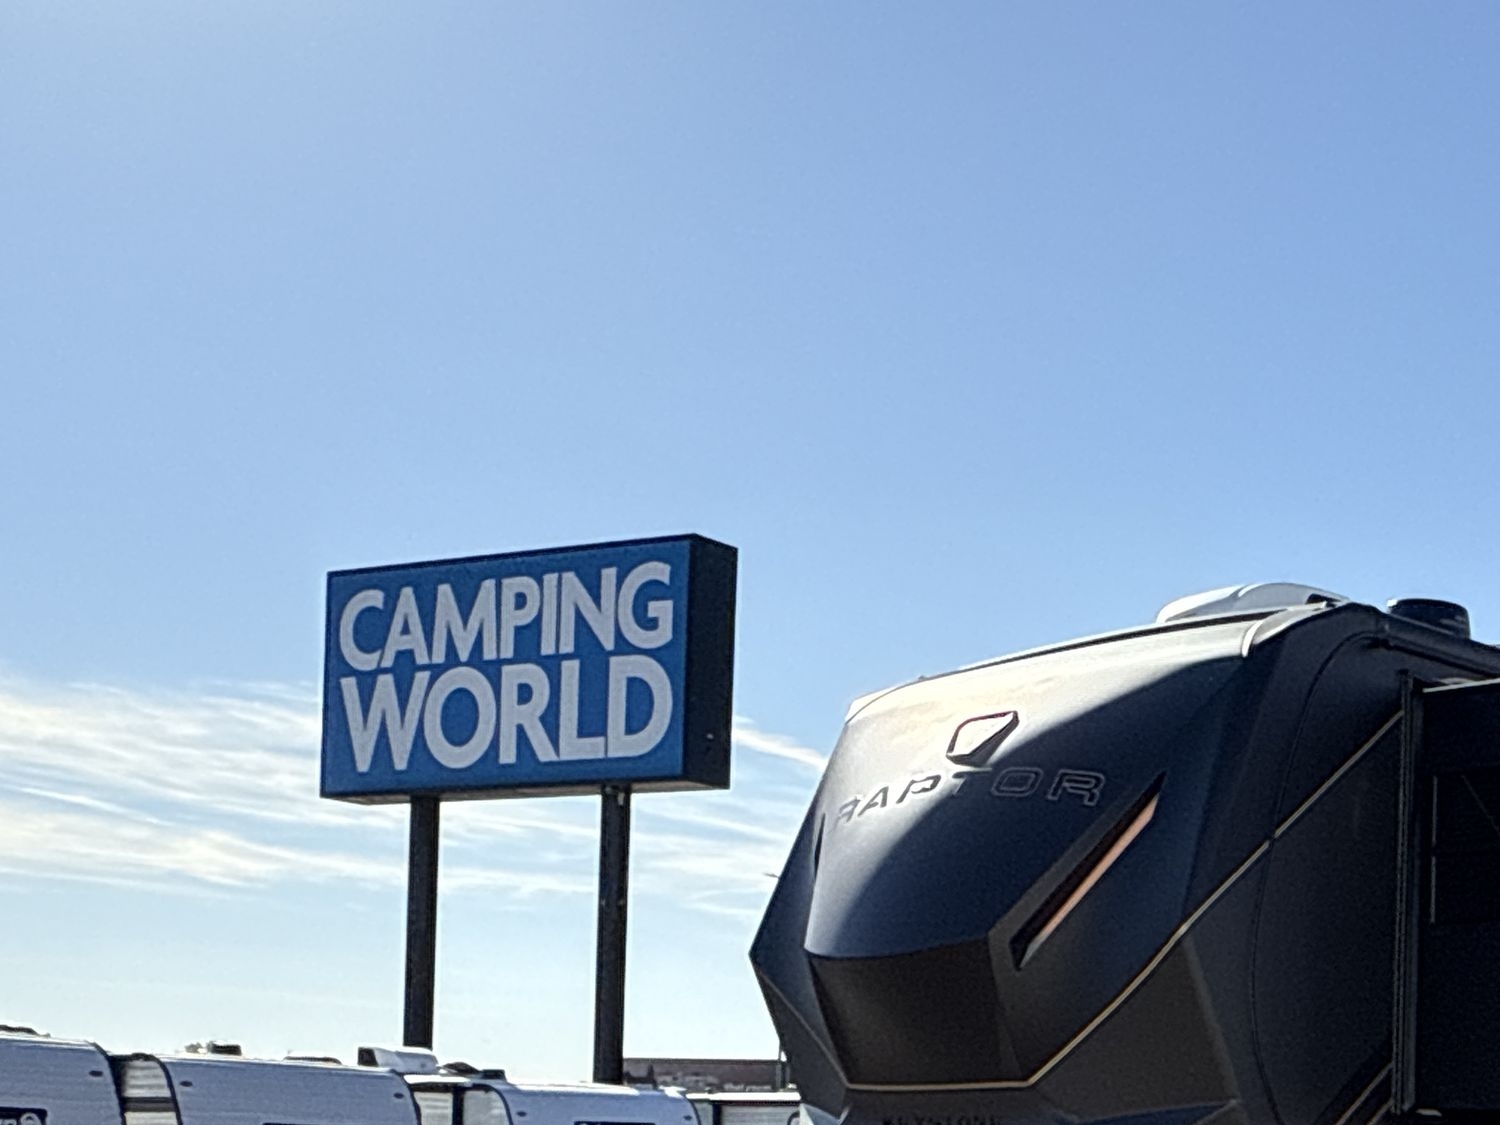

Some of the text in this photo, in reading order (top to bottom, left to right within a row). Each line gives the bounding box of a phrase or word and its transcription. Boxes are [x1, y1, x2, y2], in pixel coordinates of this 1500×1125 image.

[339, 560, 674, 671] CAMPING
[340, 654, 674, 773] WORLD
[836, 766, 1106, 823] RAPTOR
